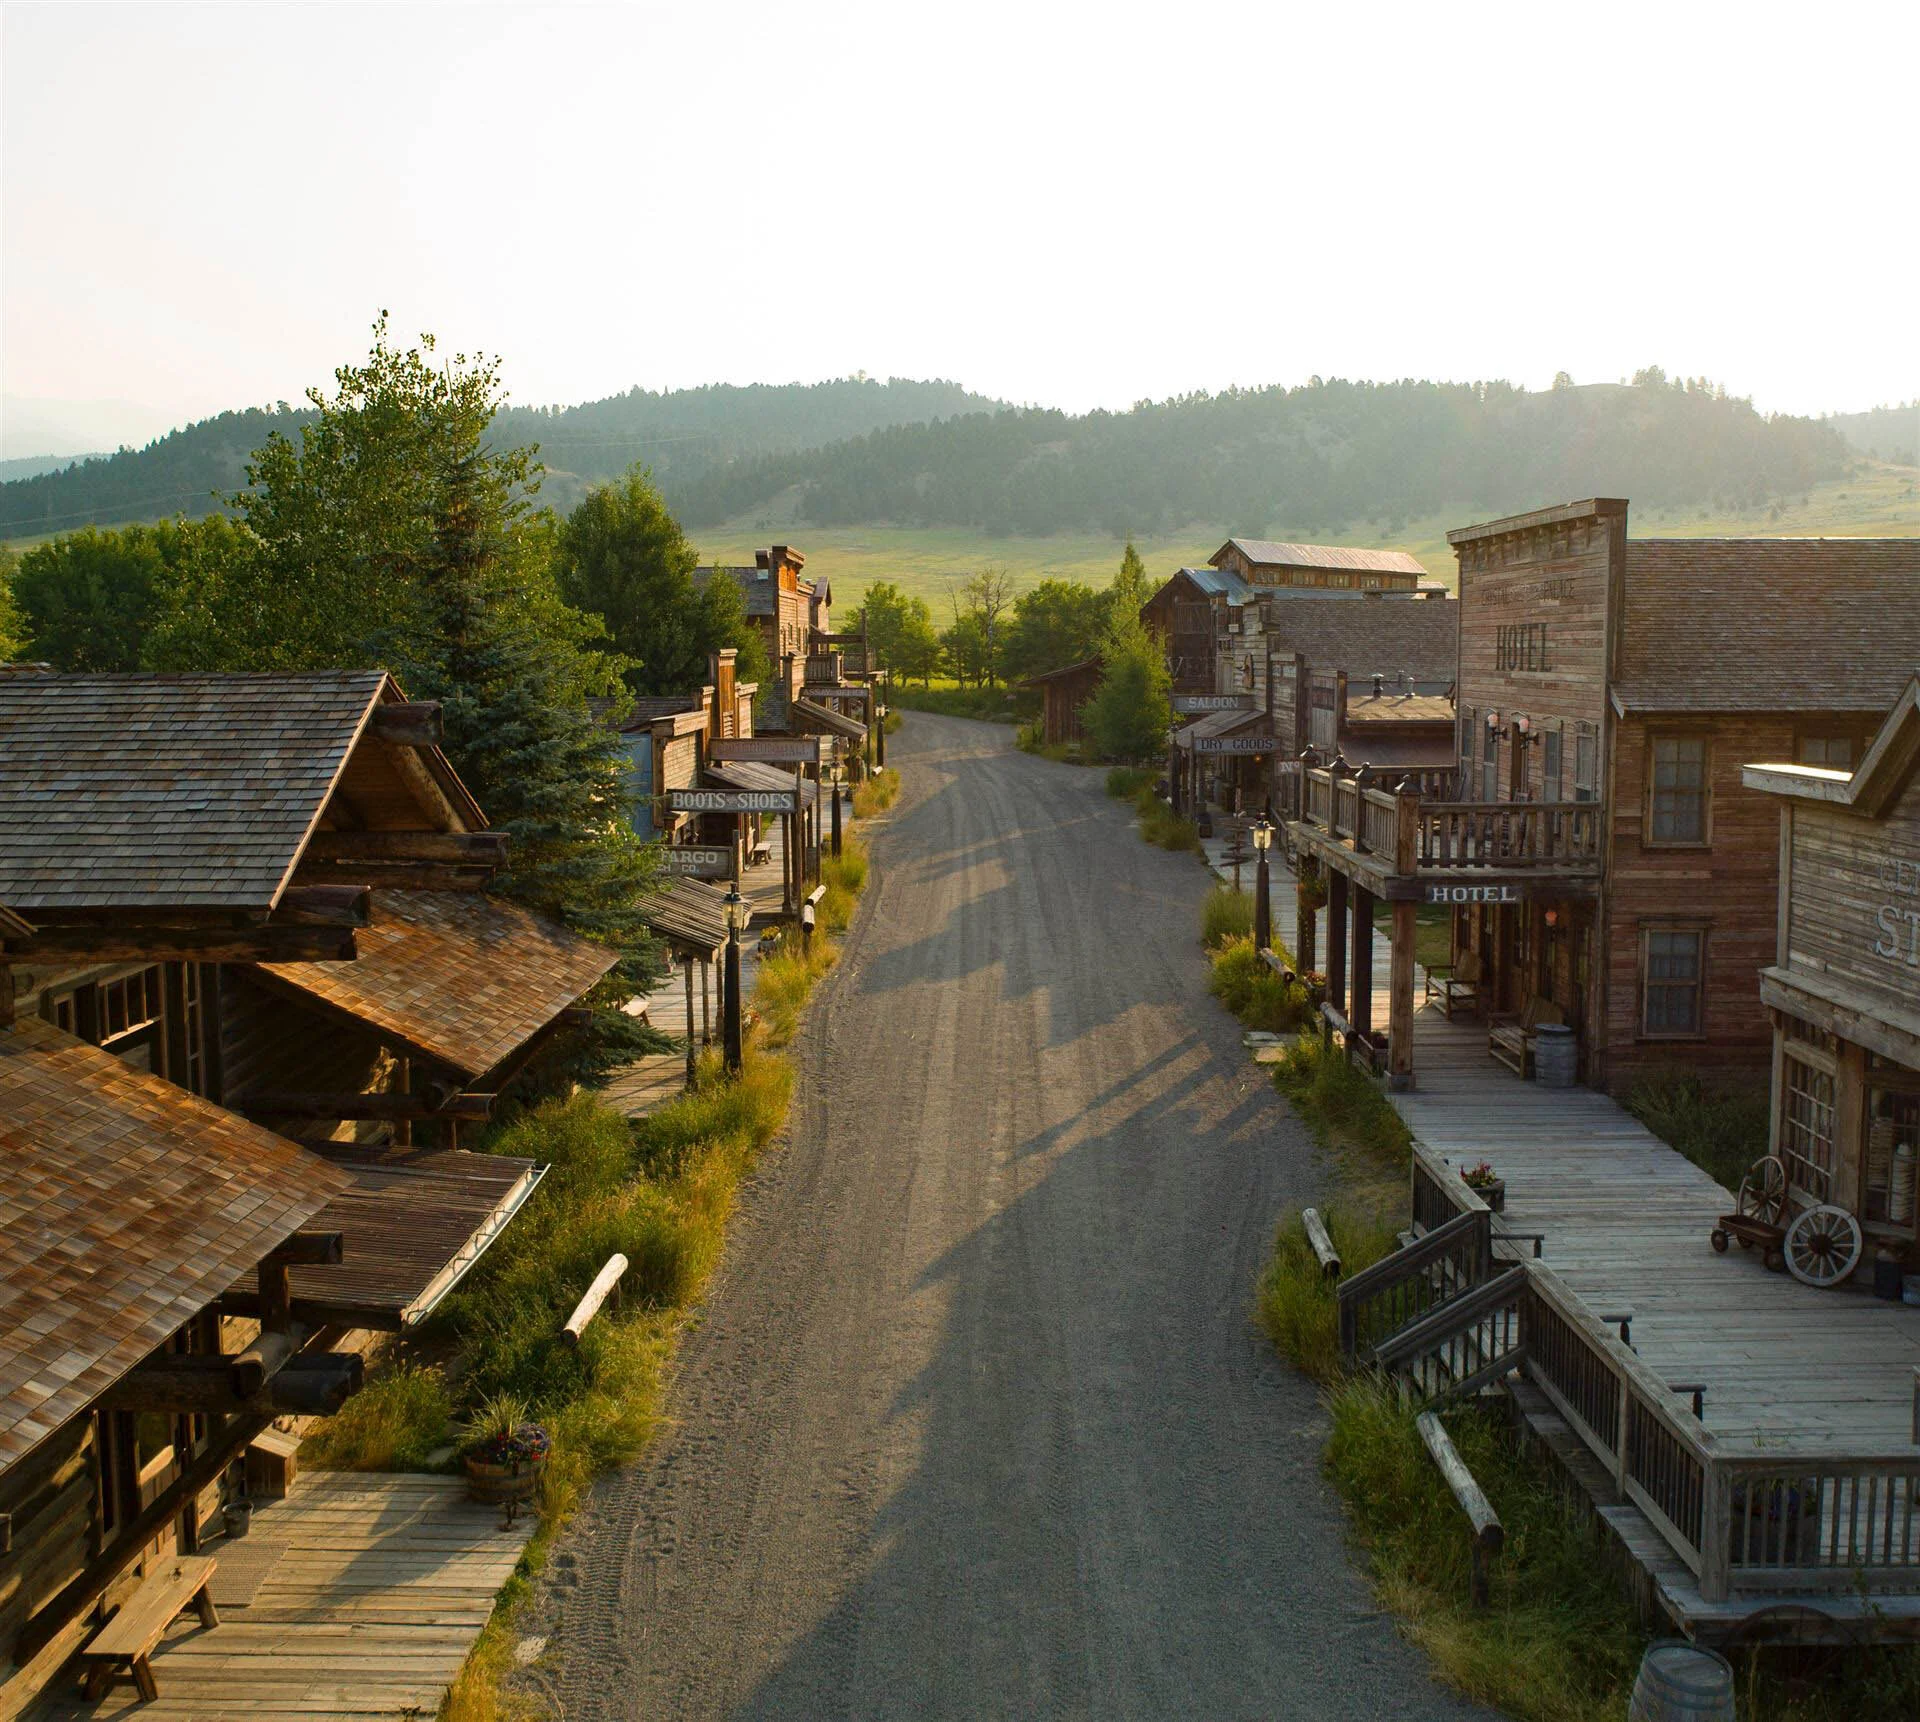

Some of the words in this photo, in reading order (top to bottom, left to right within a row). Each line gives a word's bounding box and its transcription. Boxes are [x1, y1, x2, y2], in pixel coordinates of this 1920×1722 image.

[1496, 623, 1551, 672] HOTEL
[1188, 697, 1239, 709] SALOON
[1201, 739, 1224, 750] DRY
[1232, 738, 1273, 750] GOODS
[671, 792, 726, 808] BOOTS
[737, 793, 792, 809] SHOES
[660, 850, 718, 864] FARGO
[681, 864, 700, 872] CO.
[1431, 886, 1517, 902] HOTEL
